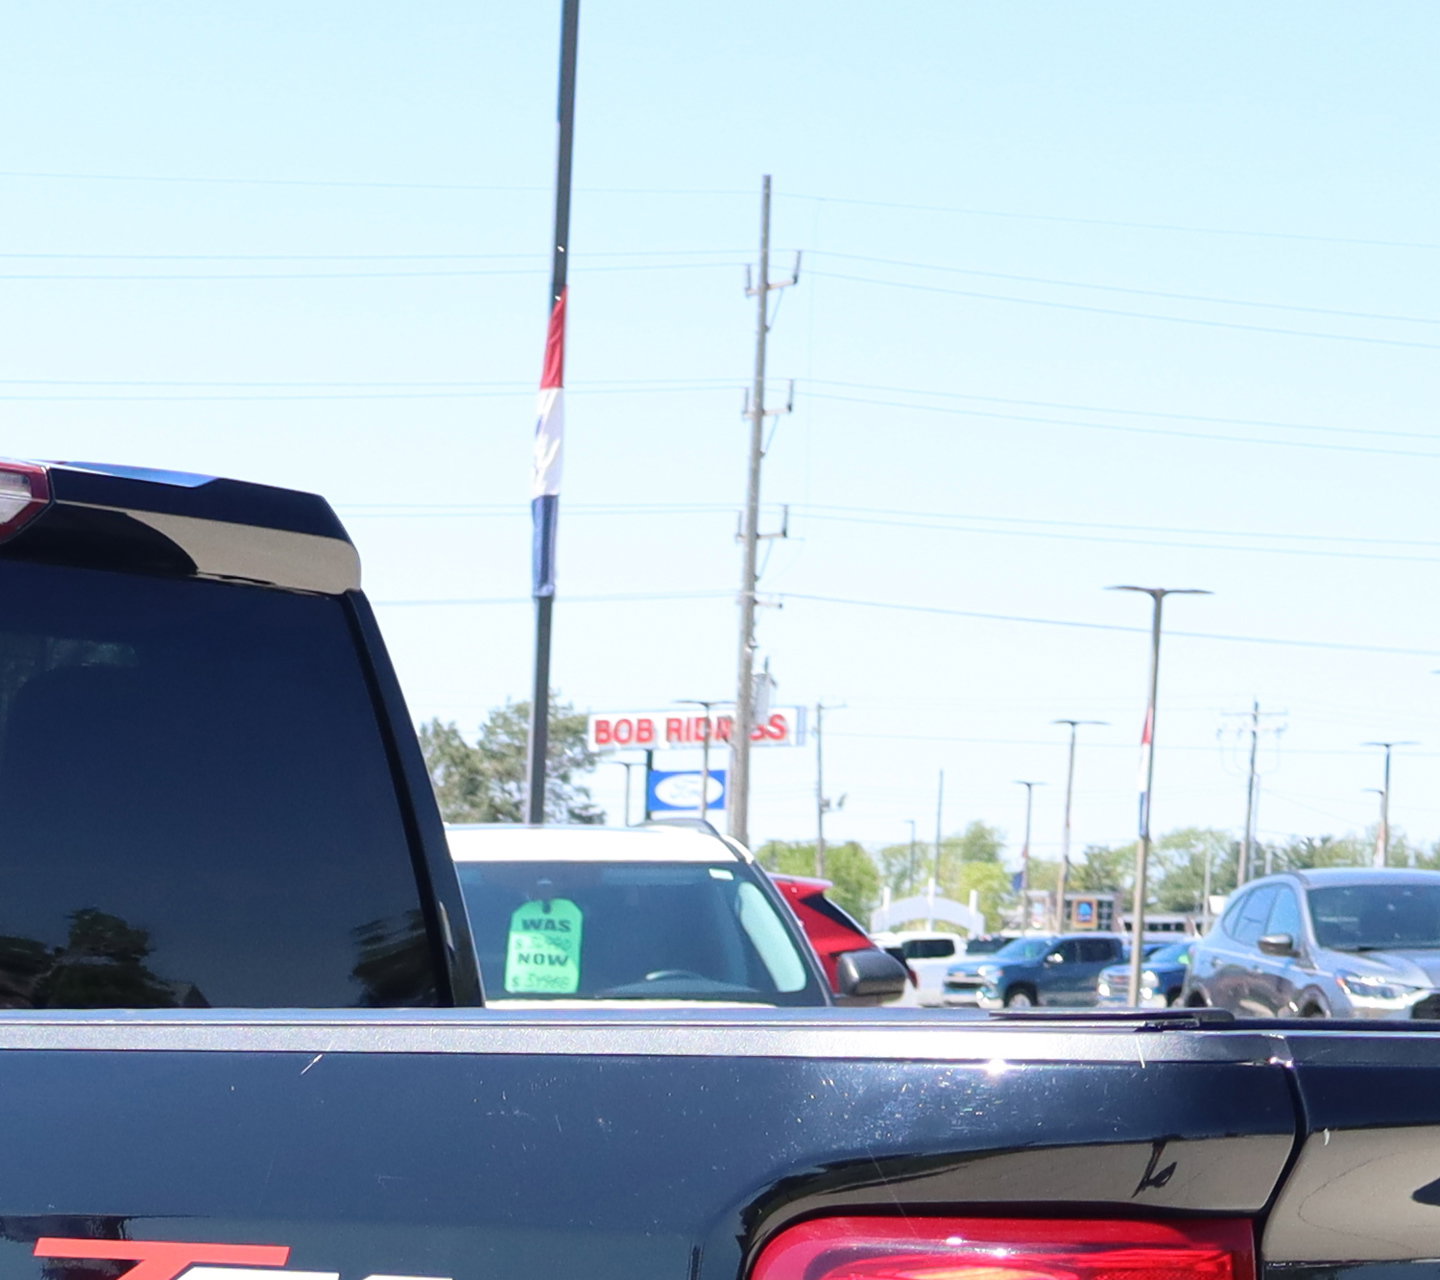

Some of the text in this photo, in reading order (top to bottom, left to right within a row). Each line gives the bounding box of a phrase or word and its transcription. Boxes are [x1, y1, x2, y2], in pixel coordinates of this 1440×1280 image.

[594, 718, 655, 744] BOB
[522, 918, 572, 932] WAS
[517, 952, 569, 967] NOW
